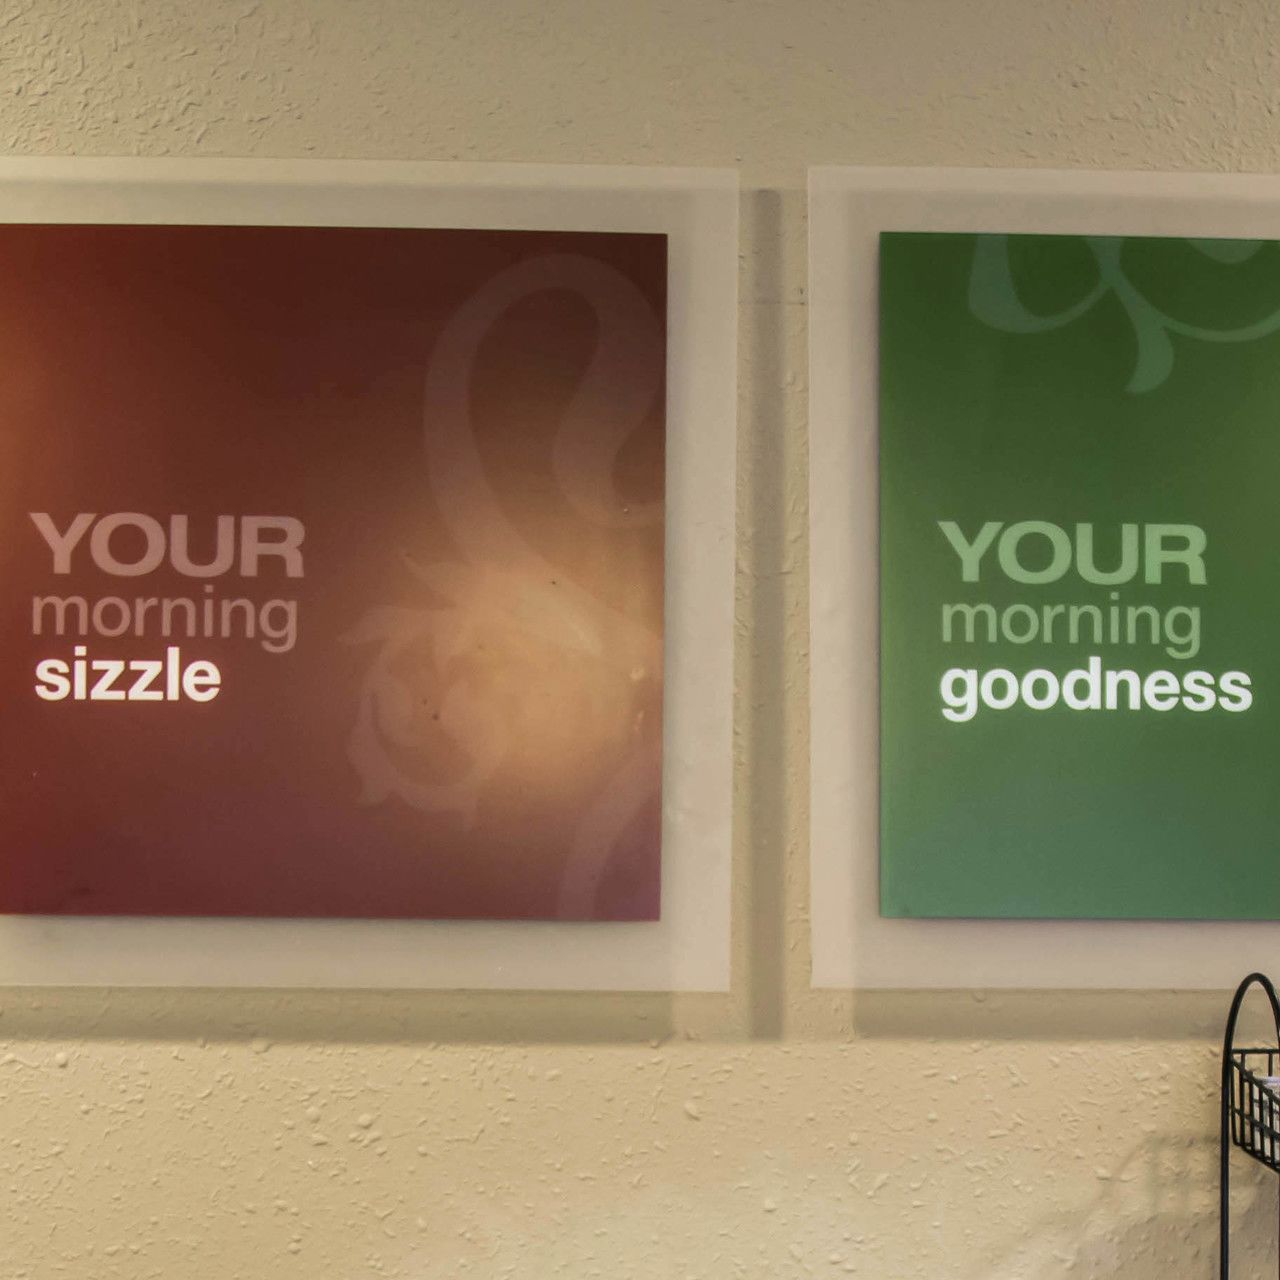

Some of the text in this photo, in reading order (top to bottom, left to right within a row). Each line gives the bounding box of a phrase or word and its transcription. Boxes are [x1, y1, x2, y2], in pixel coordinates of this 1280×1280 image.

[29, 512, 305, 578] YOUR
[937, 520, 1208, 585] YOUR
[32, 585, 298, 653] morning
[942, 592, 1201, 659] morning
[35, 646, 221, 702] sizzle
[940, 656, 1253, 722] goodness
